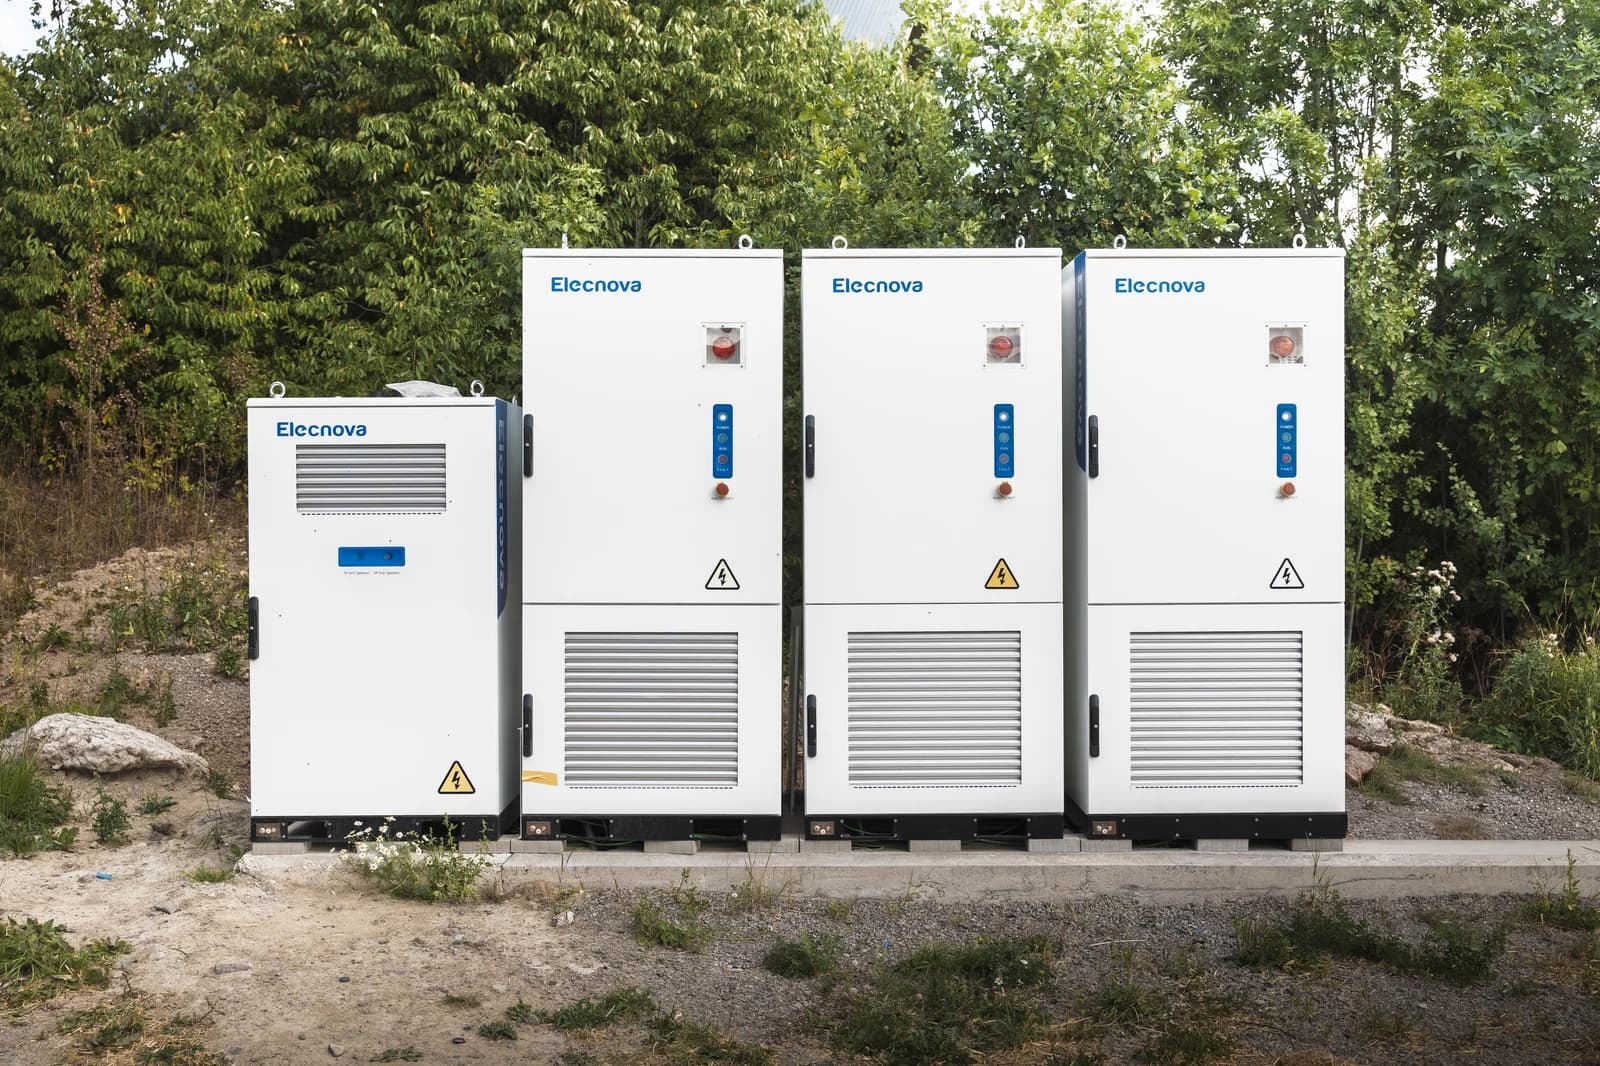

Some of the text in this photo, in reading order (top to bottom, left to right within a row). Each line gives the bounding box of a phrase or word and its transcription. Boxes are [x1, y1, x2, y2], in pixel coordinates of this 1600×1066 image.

[551, 277, 641, 292] Elecnova
[833, 278, 923, 293] Elecnova
[1115, 278, 1206, 293] Elecnova
[277, 422, 367, 437] Elecnova
[498, 419, 506, 590] Elecnova
